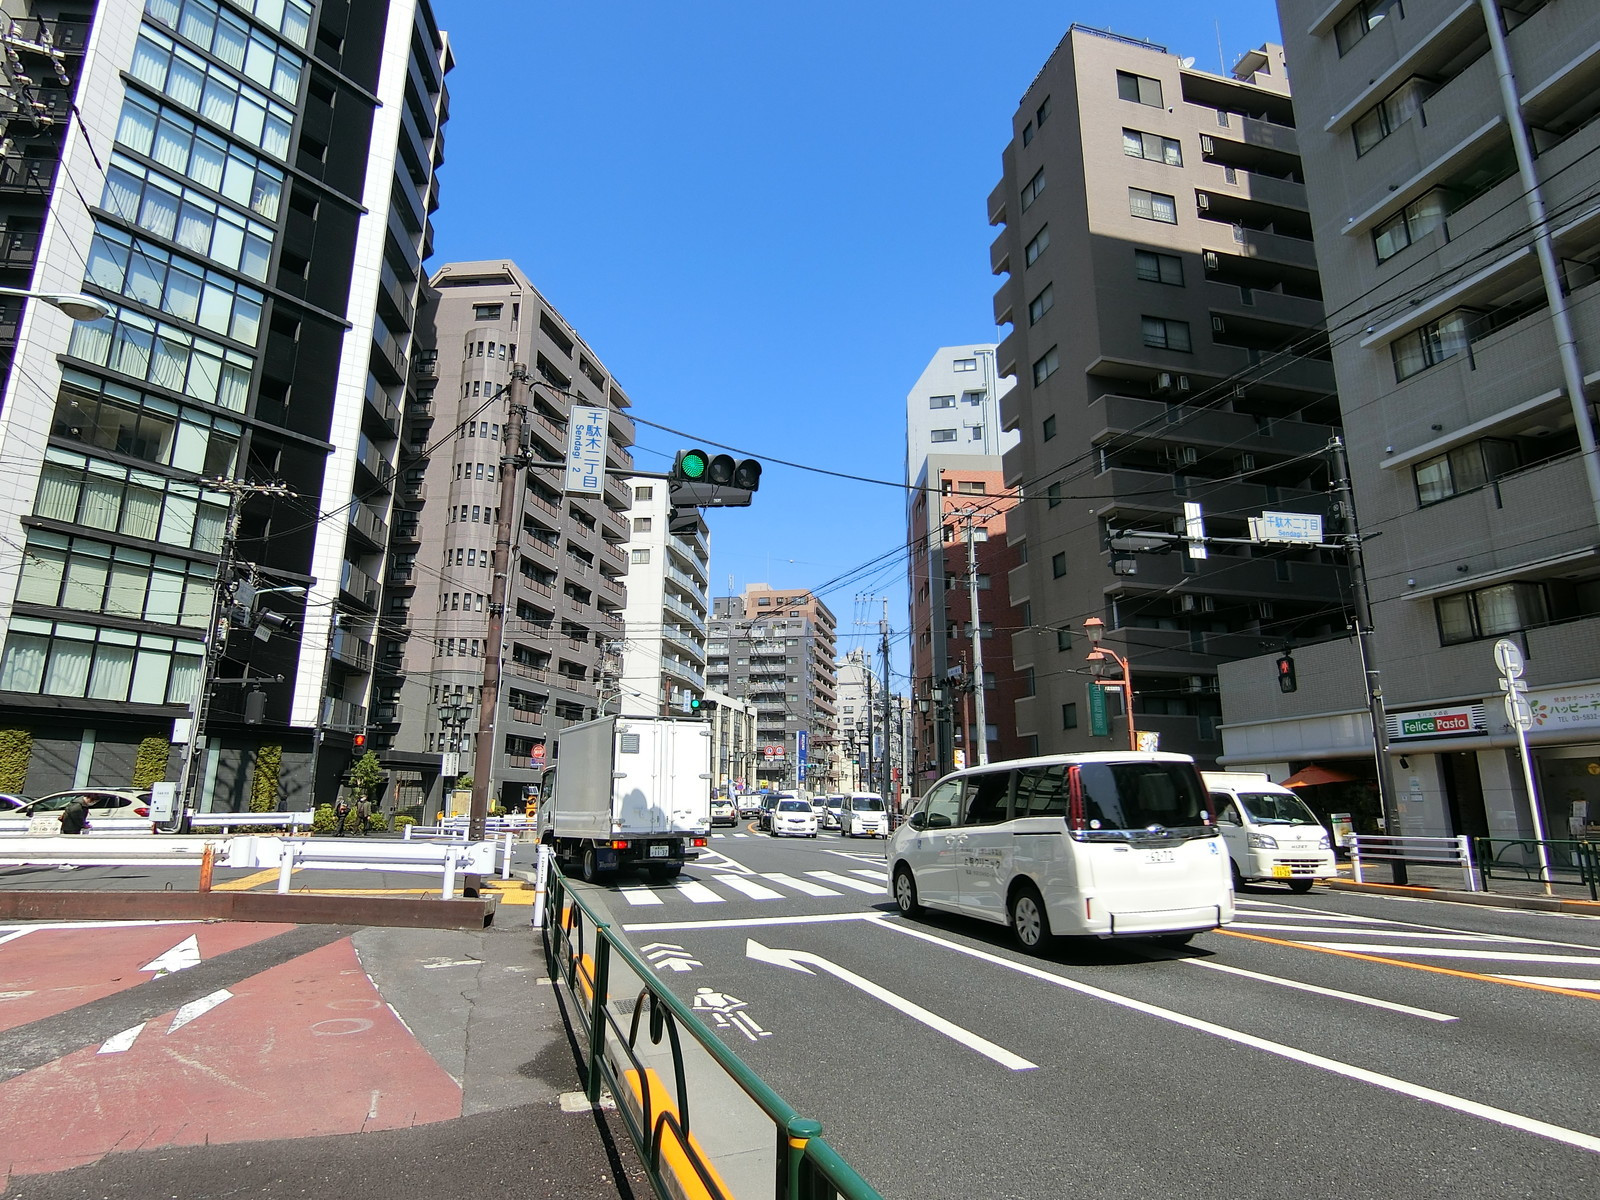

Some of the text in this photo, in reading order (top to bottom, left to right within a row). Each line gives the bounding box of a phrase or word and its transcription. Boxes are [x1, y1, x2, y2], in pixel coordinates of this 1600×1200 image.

[572, 424, 584, 459] Sendagi
[583, 412, 603, 488] 千駄木二丁目
[1266, 516, 1318, 530] 千駄木二丁目
[1404, 718, 1466, 732] Felice Pasto
